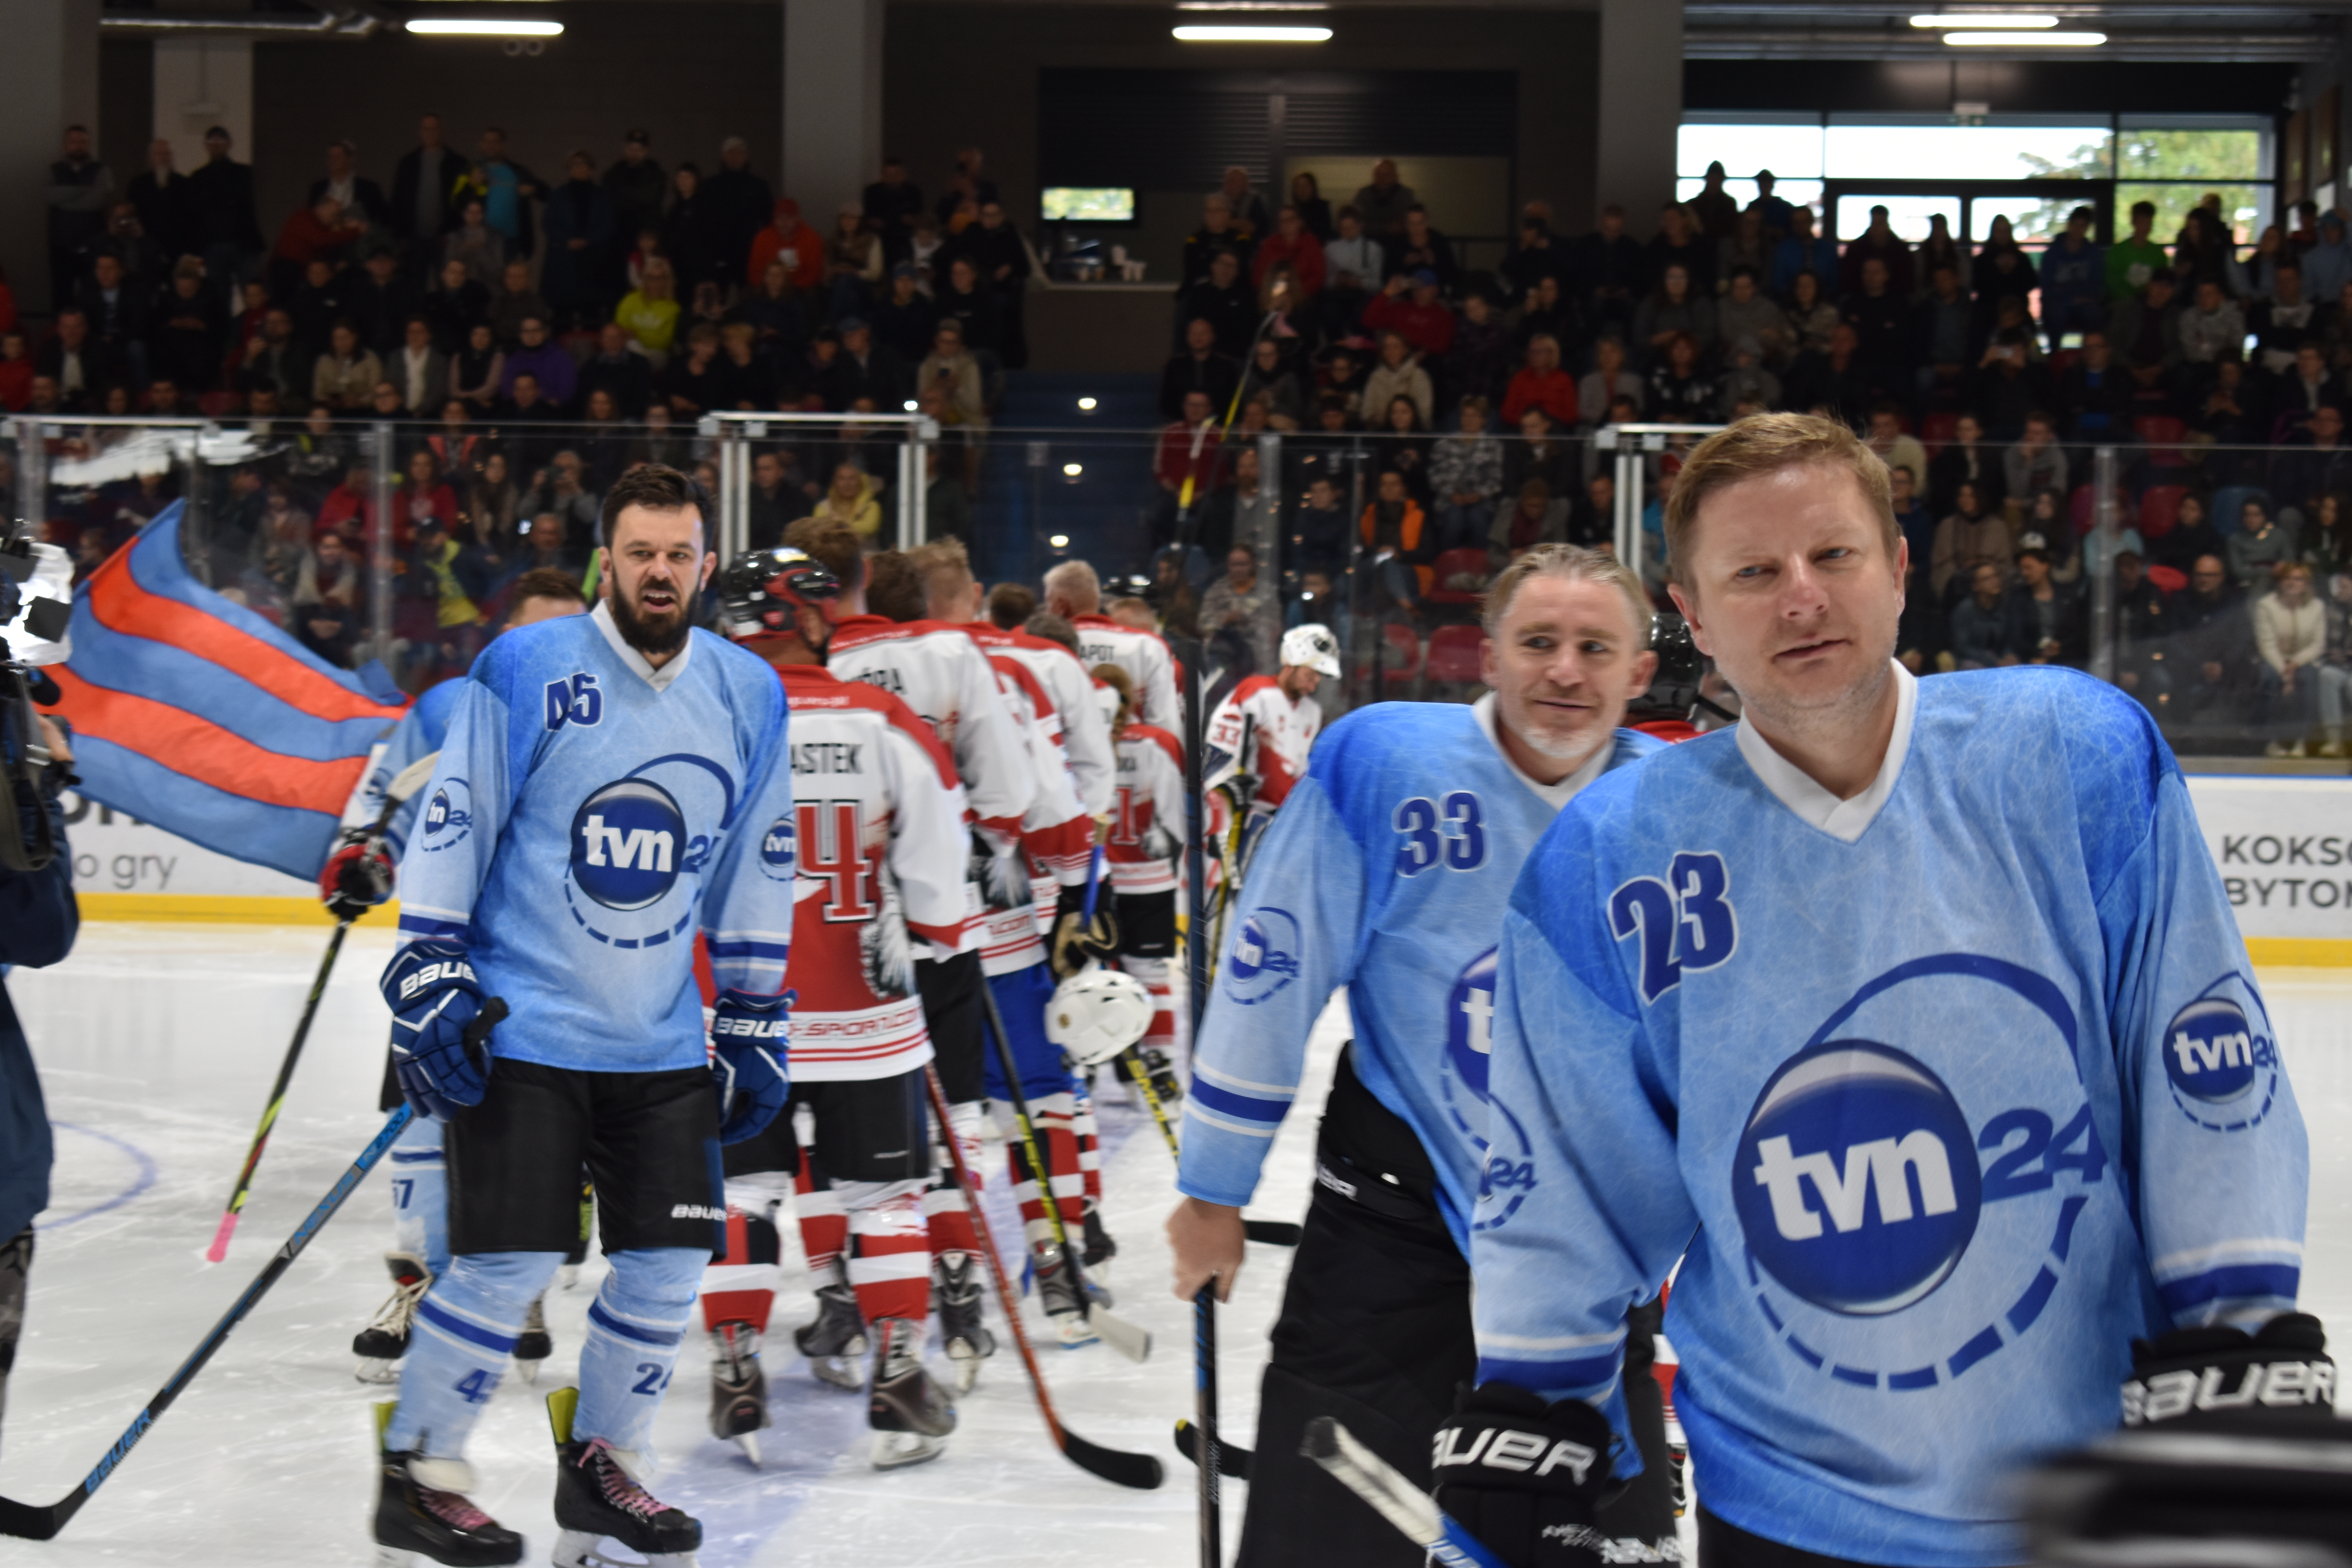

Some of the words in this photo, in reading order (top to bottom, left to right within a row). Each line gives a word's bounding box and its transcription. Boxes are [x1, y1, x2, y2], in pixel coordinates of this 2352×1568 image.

[583, 815, 674, 873] tvn
[1392, 789, 1487, 878] 33
[2223, 833, 2352, 866] KOKS
[111, 854, 177, 890] gry
[2224, 876, 2352, 909] BYTO
[1607, 850, 1739, 1006] 23
[2174, 1030, 2252, 1075] tvn
[1754, 1129, 1958, 1241] tvn
[1977, 1102, 2107, 1205] 24
